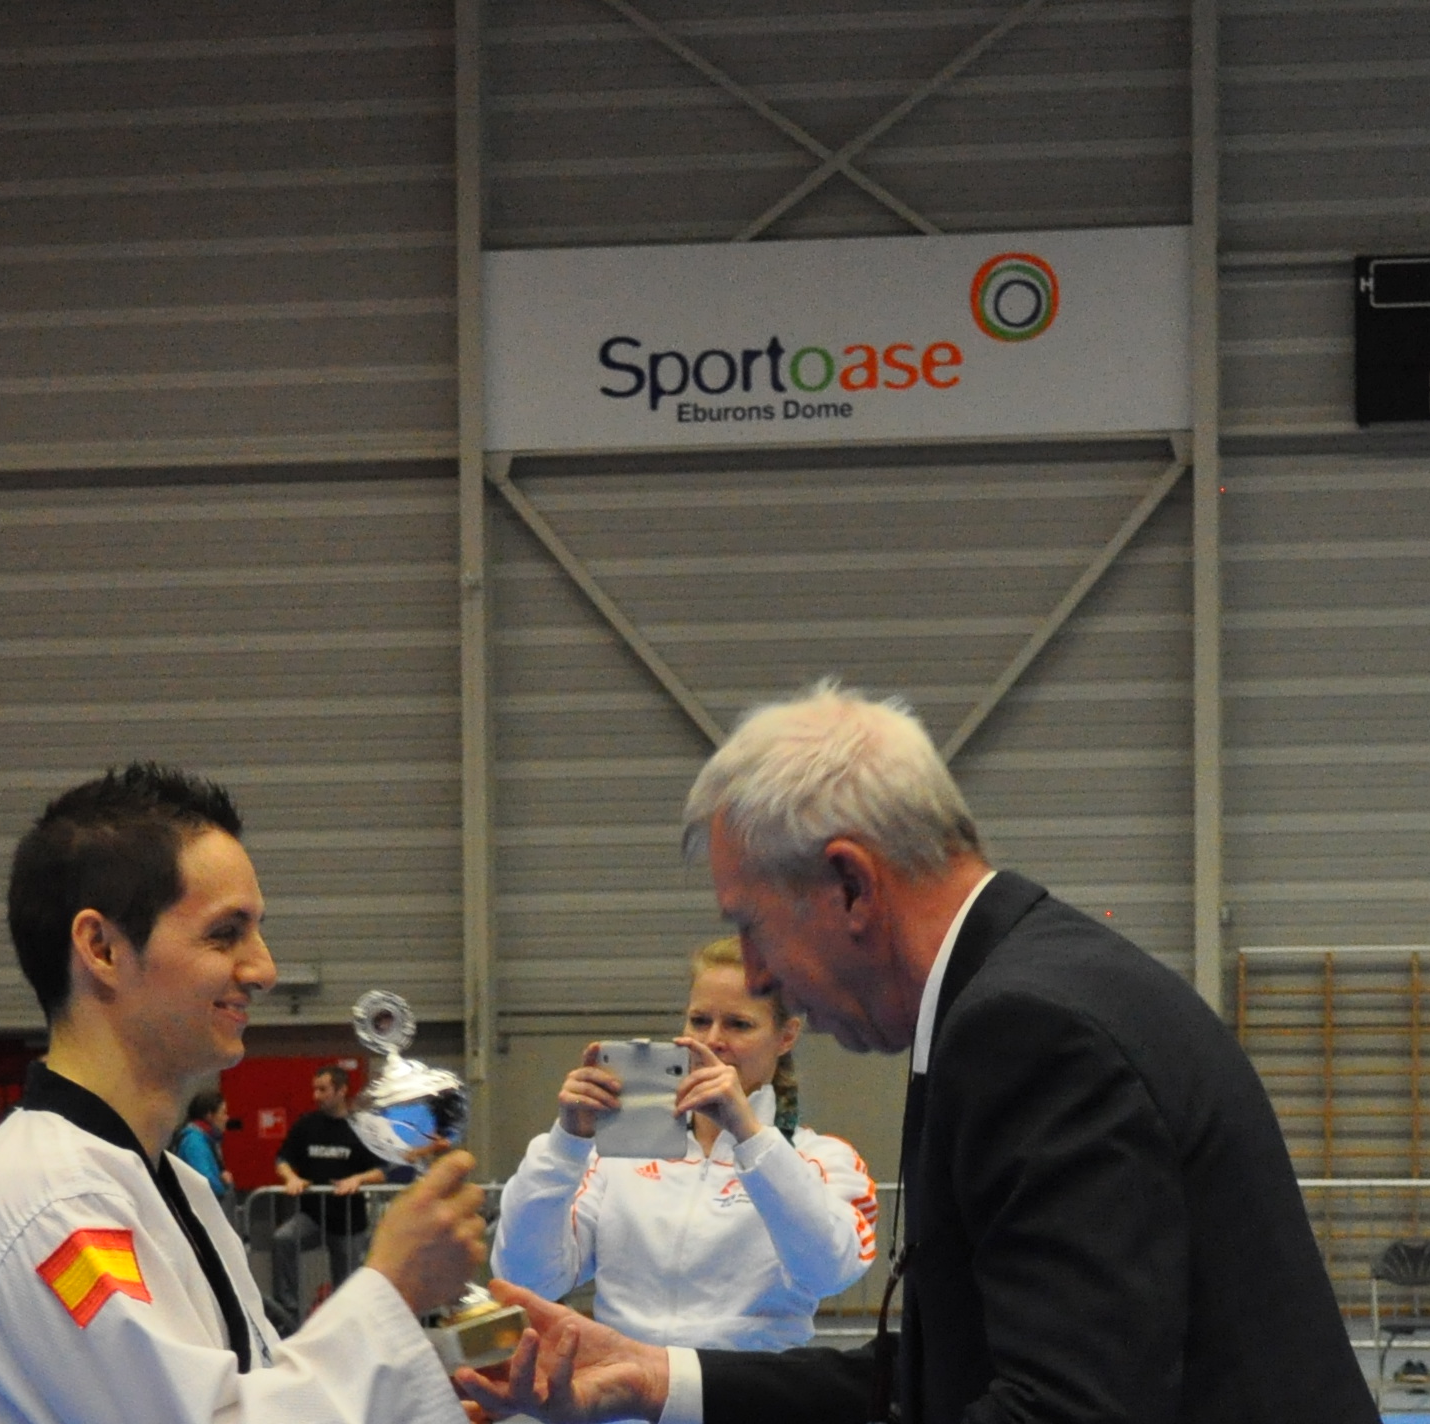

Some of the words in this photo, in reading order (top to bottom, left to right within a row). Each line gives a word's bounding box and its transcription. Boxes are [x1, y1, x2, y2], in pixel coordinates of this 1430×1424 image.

[598, 335, 964, 411] Sportoase
[676, 402, 775, 423] Eburons
[782, 399, 854, 421] Dome
